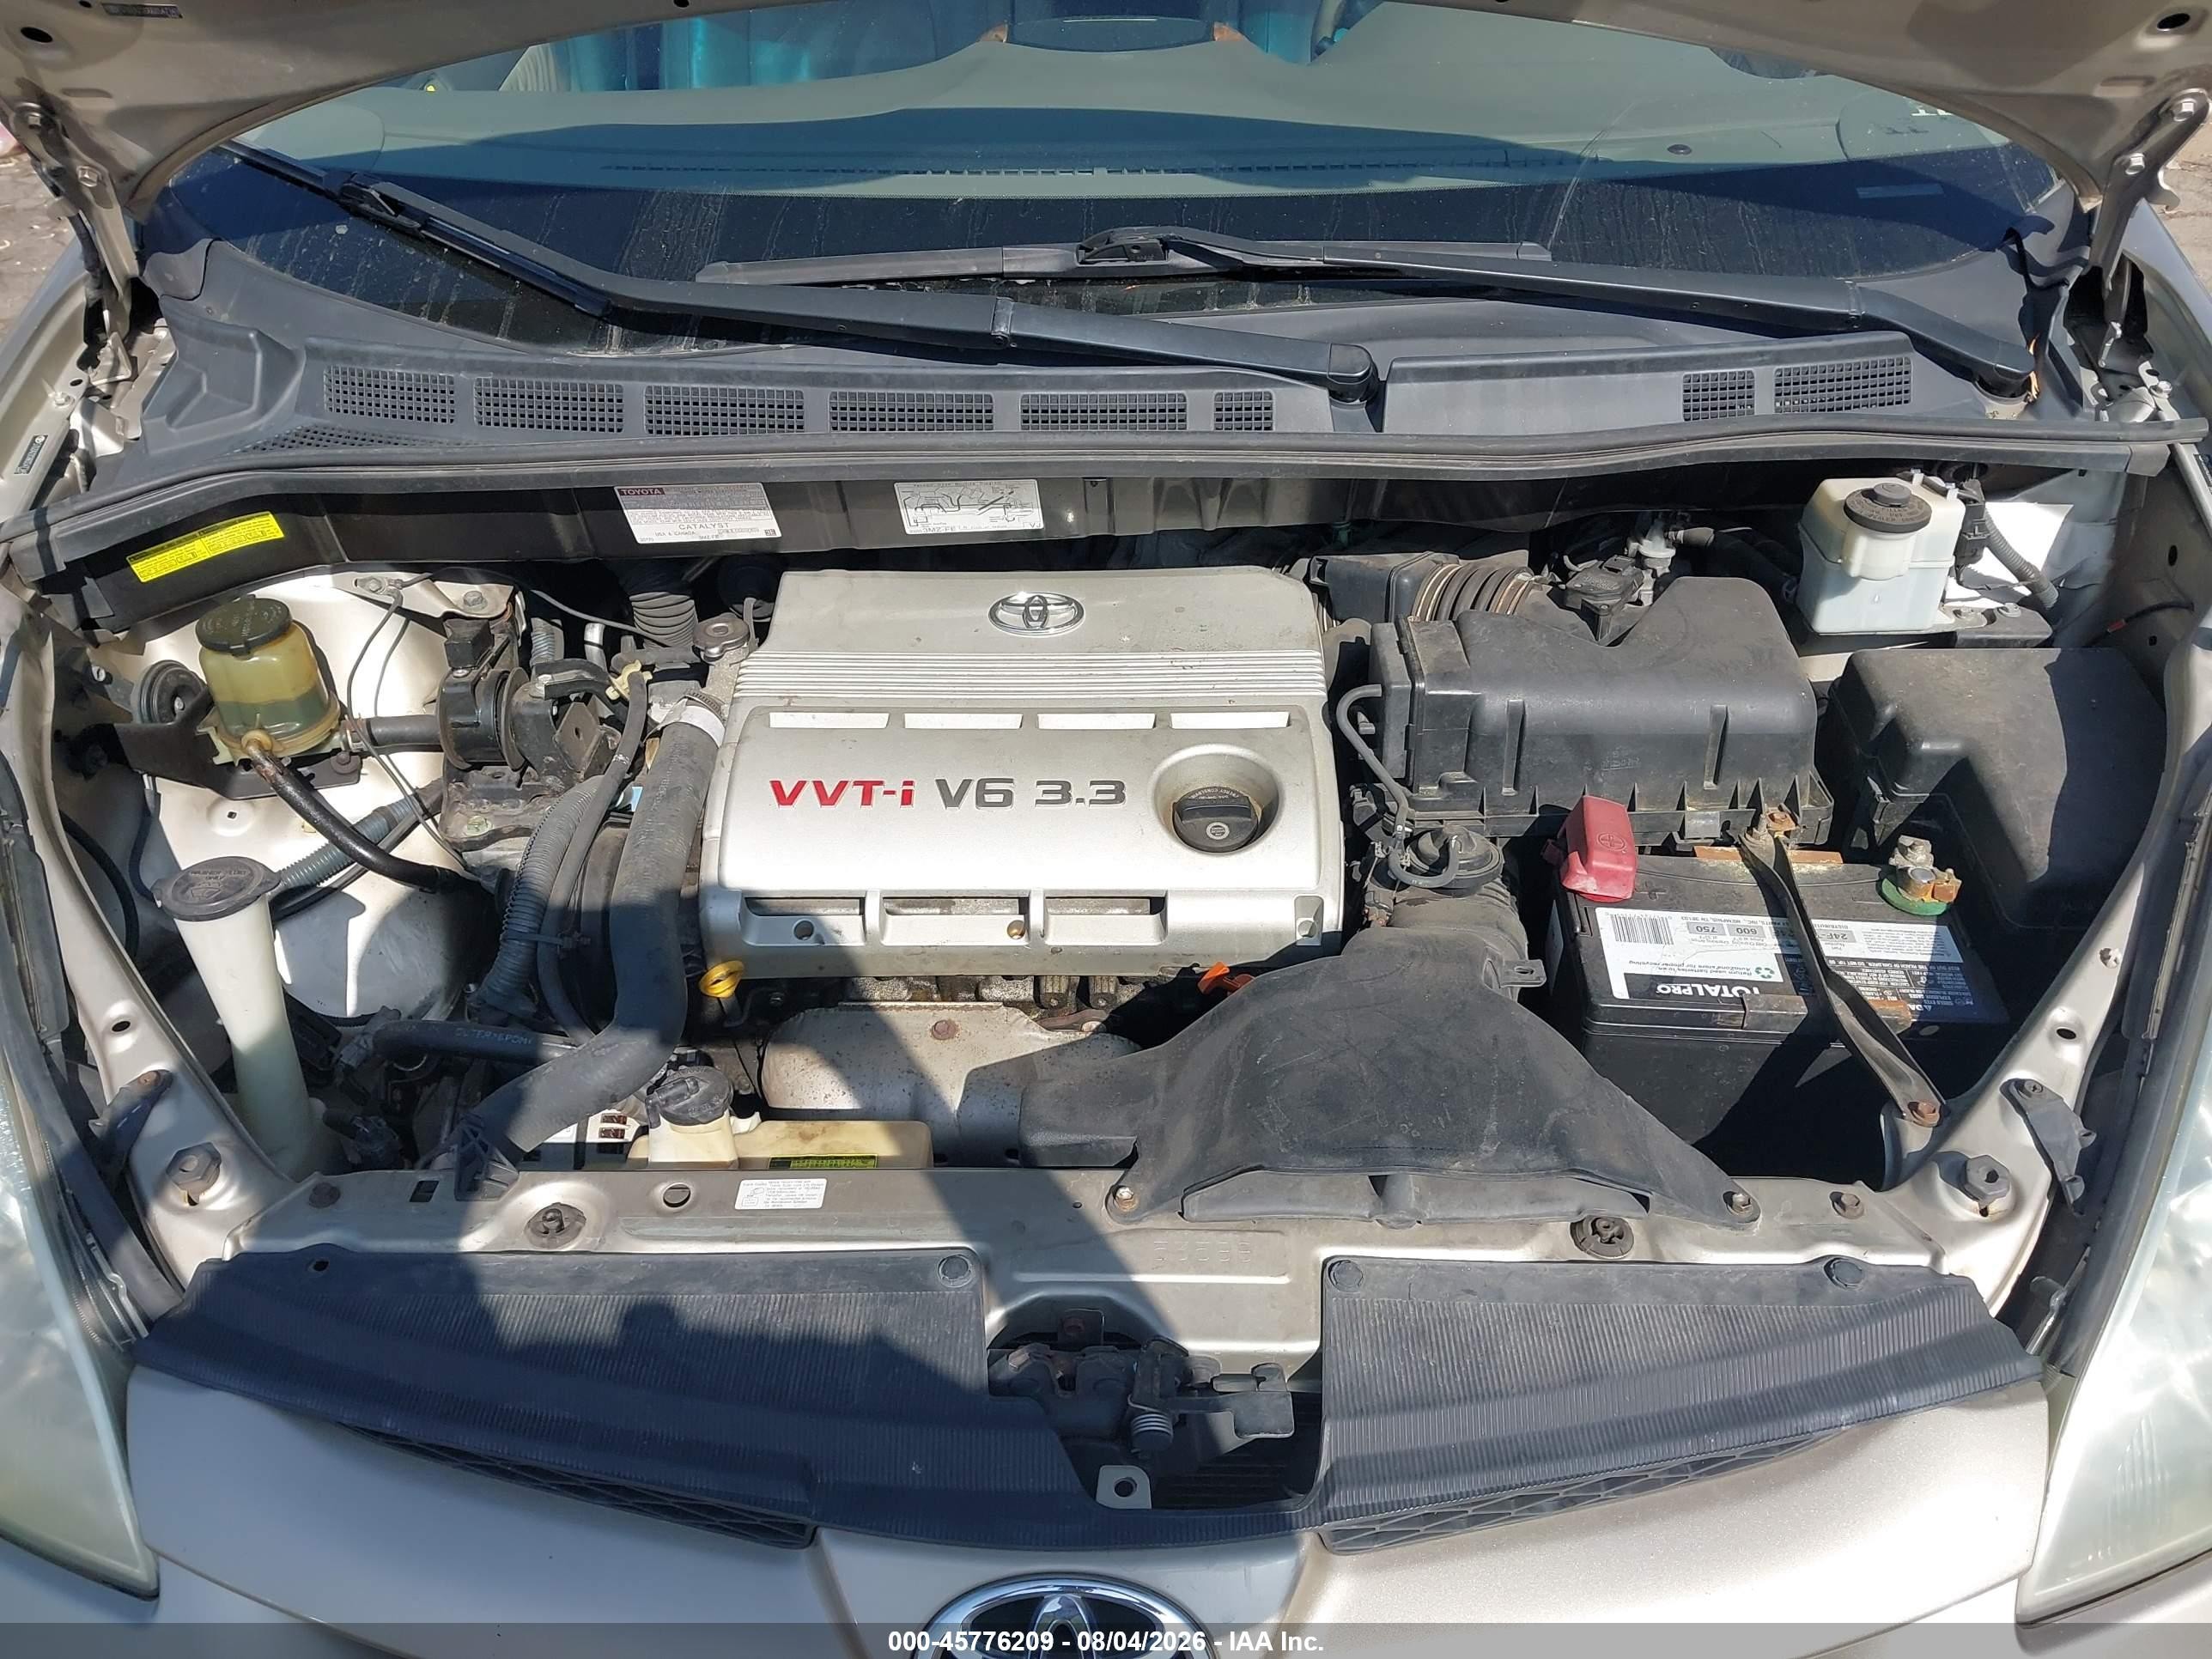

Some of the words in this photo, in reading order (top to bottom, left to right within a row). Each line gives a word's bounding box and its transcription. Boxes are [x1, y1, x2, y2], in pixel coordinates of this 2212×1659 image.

[770, 780, 915, 807] VVT-i
[936, 778, 1015, 808] V6
[1034, 779, 1127, 805] 3.3
